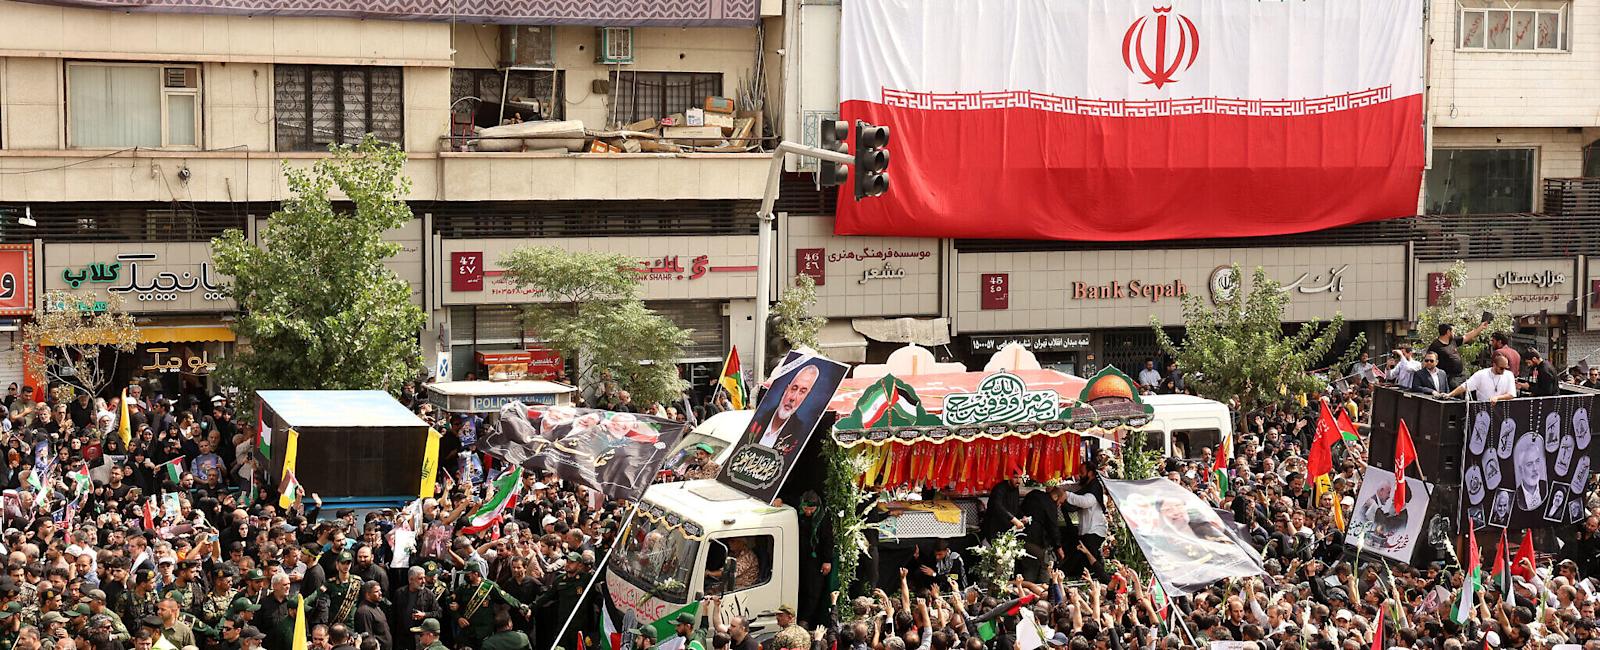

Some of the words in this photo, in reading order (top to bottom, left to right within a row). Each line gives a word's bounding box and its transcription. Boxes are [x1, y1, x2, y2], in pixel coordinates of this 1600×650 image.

[460, 256, 475, 264] 47
[828, 250, 855, 262] هنری
[856, 248, 893, 261] فرهنگی
[894, 249, 930, 260] موسسه
[62, 262, 121, 288] کلاب
[859, 262, 905, 284] مشعر
[1494, 270, 1565, 290] هزاردستان
[1072, 280, 1125, 300] Bank
[1129, 279, 1188, 303] Sepah
